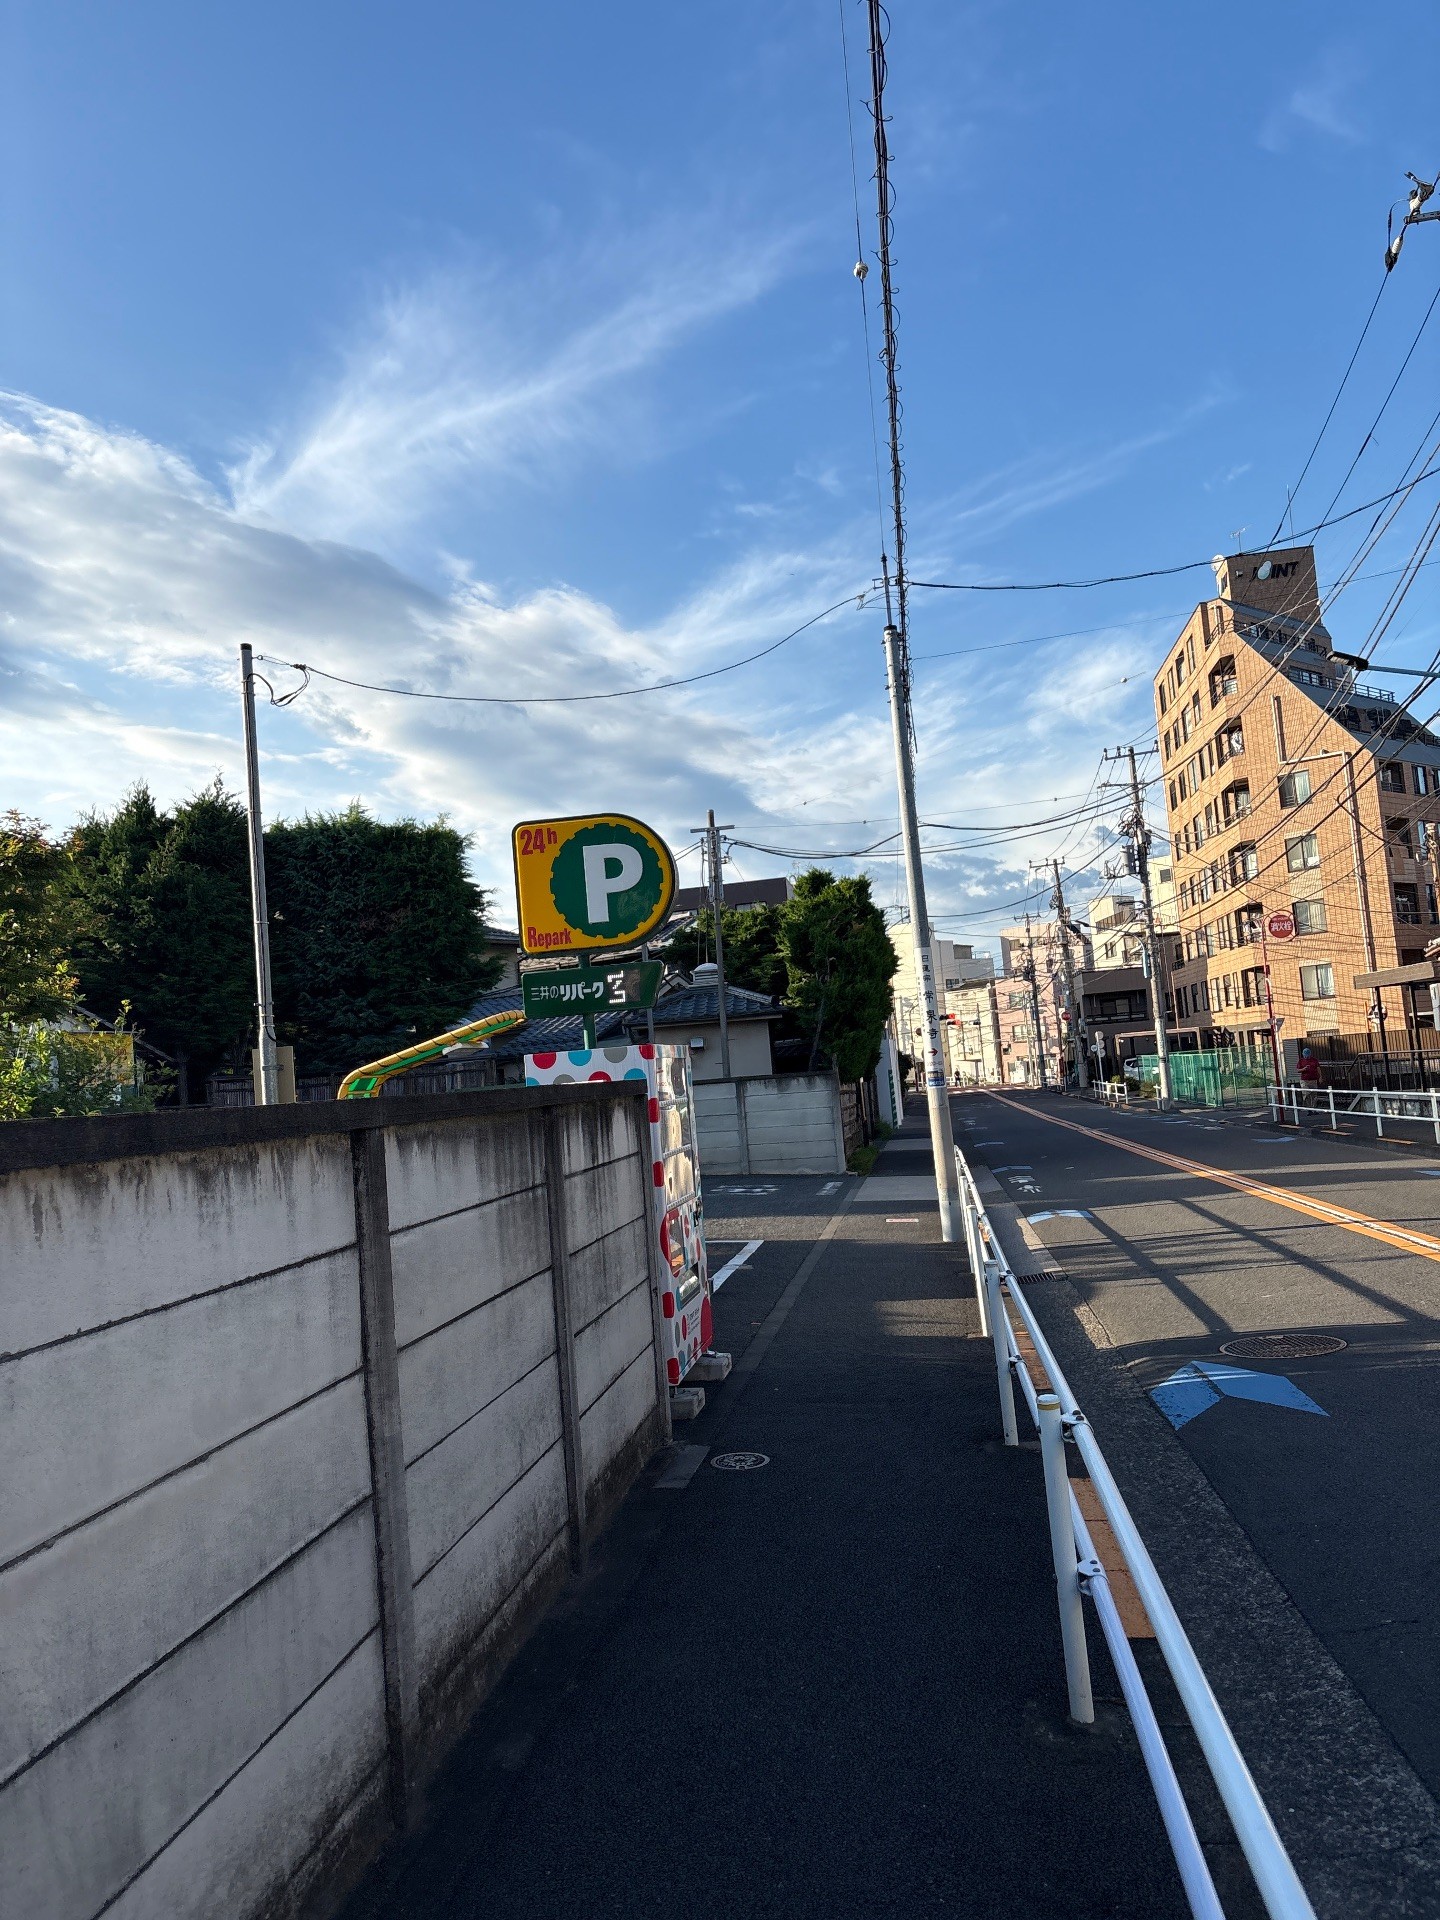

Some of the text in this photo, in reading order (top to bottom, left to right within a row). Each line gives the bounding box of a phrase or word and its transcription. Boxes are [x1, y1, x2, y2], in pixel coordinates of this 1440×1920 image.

[582, 843, 643, 923] P
[1270, 920, 1292, 931] 消火栓
[527, 927, 572, 948] Repark
[530, 981, 604, 1001] 三井のリパーク
[924, 990, 938, 1039] 常泉寺
